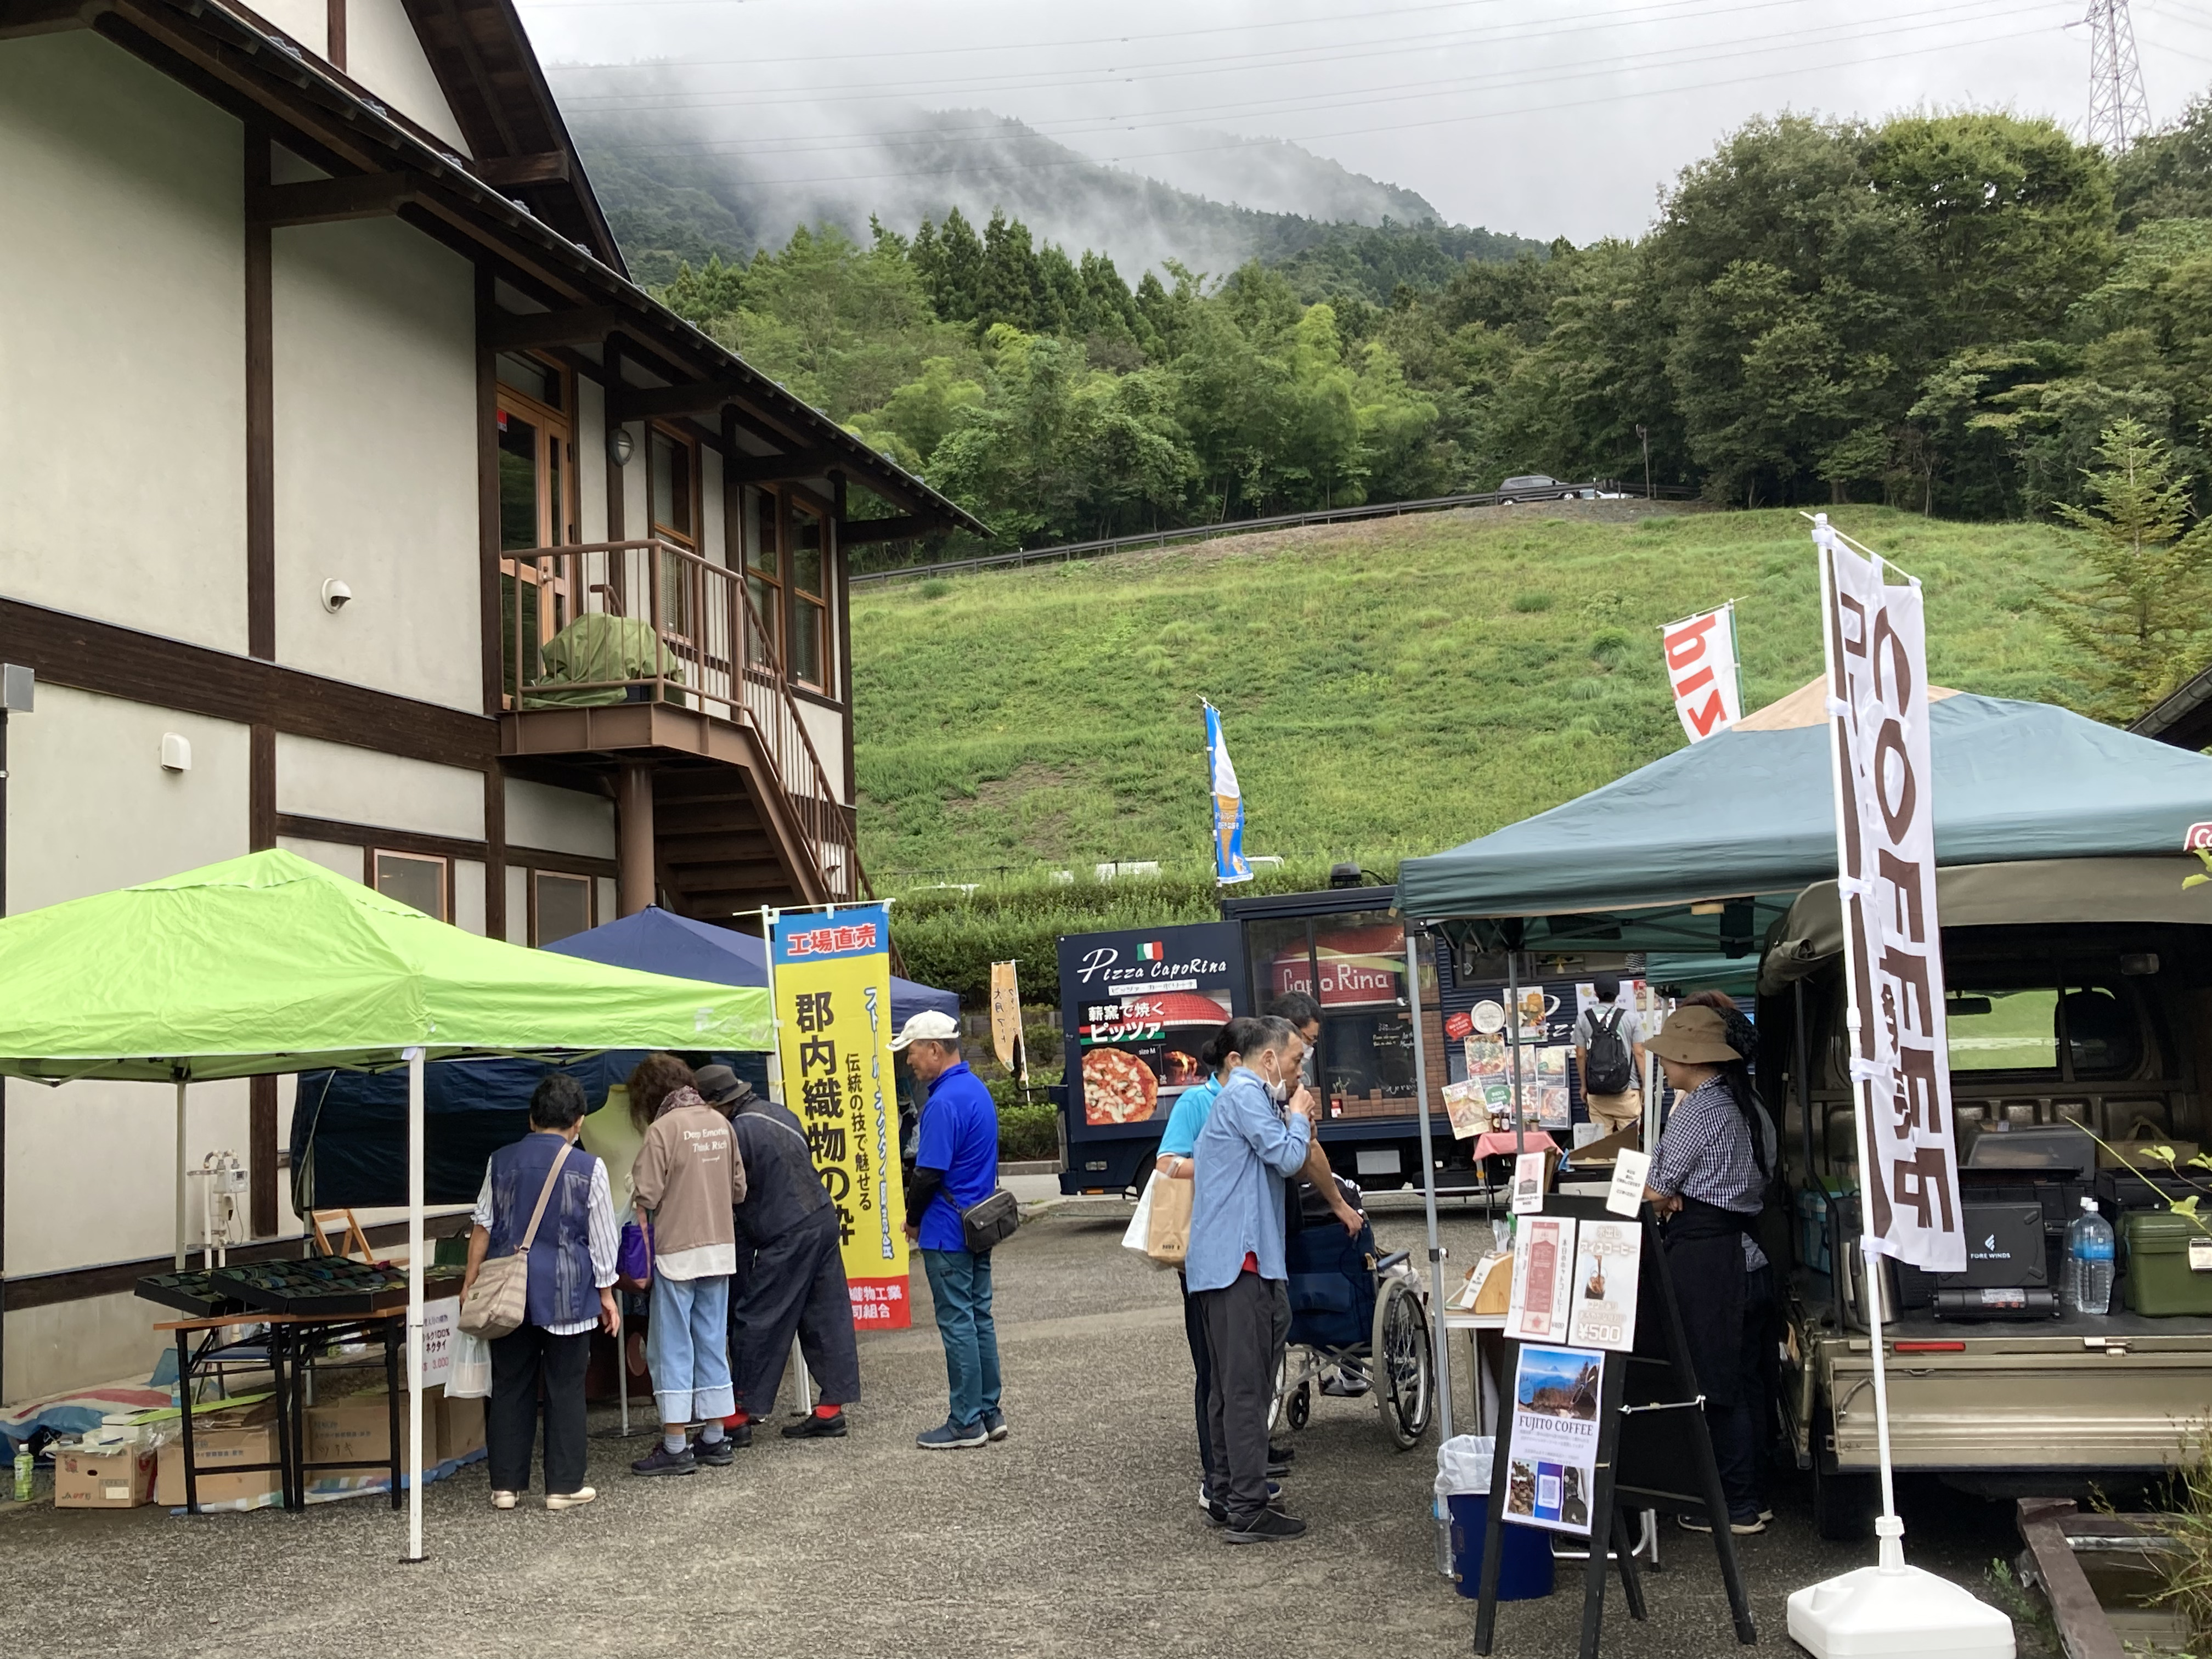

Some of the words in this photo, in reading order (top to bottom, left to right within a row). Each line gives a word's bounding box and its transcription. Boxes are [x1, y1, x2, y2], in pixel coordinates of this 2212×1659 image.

[787, 923, 876, 956] 工場直売
[1077, 947, 1144, 983] Pizza
[1151, 958, 1227, 979] CapoRina
[1088, 1001, 1165, 1022] 薪窯で焼く
[1091, 1021, 1161, 1043] ピッツァ
[683, 1130, 701, 1141] Deep
[845, 1053, 872, 1211] 伝統の技で魅せる
[692, 1143, 710, 1153] Think
[1579, 1242, 1638, 1256] アイスコーヒー
[1578, 1323, 1621, 1342] ¥500
[426, 1340, 447, 1353] ネクタイ
[1519, 1415, 1553, 1431] FUJITO
[1555, 1420, 1594, 1436] COFFEE
